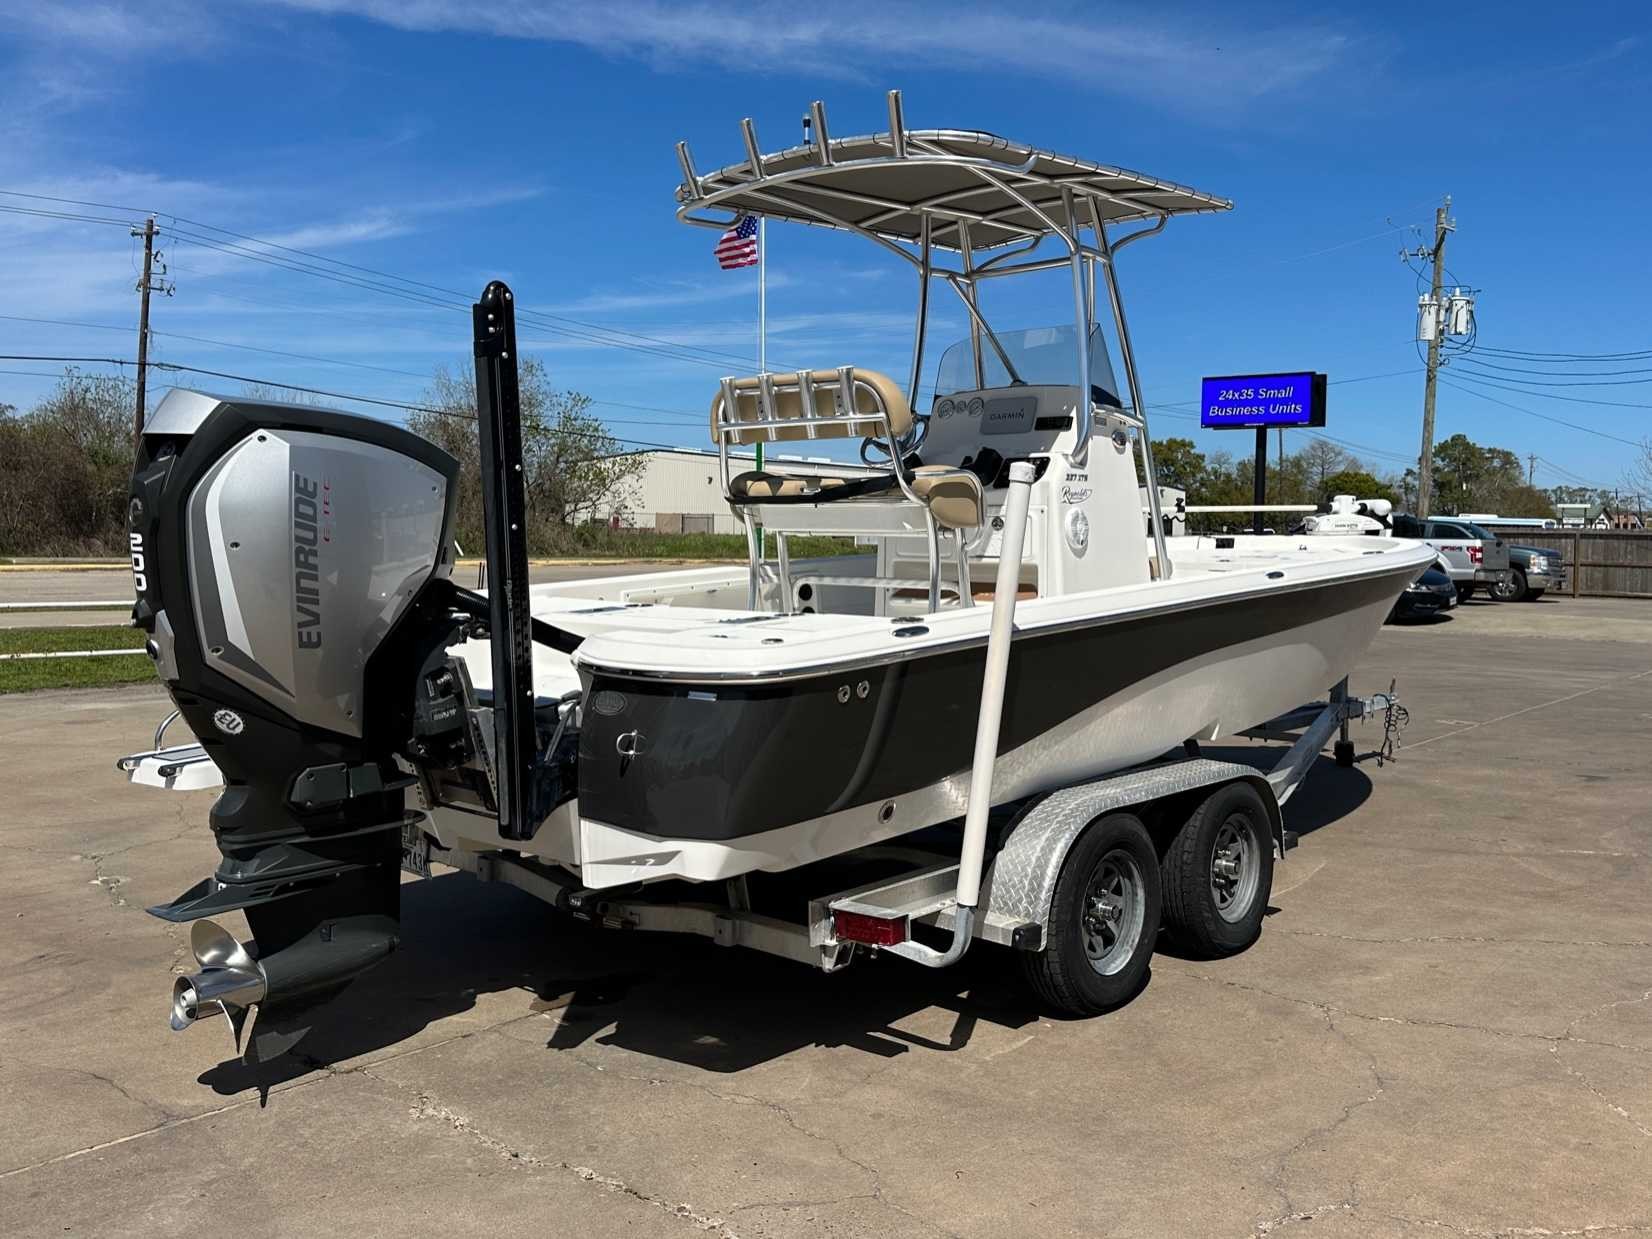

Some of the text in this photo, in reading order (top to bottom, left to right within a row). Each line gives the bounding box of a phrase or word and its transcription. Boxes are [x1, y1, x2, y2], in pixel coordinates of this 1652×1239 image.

[1219, 386, 1294, 401] 24x35 Small
[990, 410, 1025, 421] GARMIN
[1209, 402, 1303, 417] Business Units
[294, 473, 322, 649] EVINRUDE
